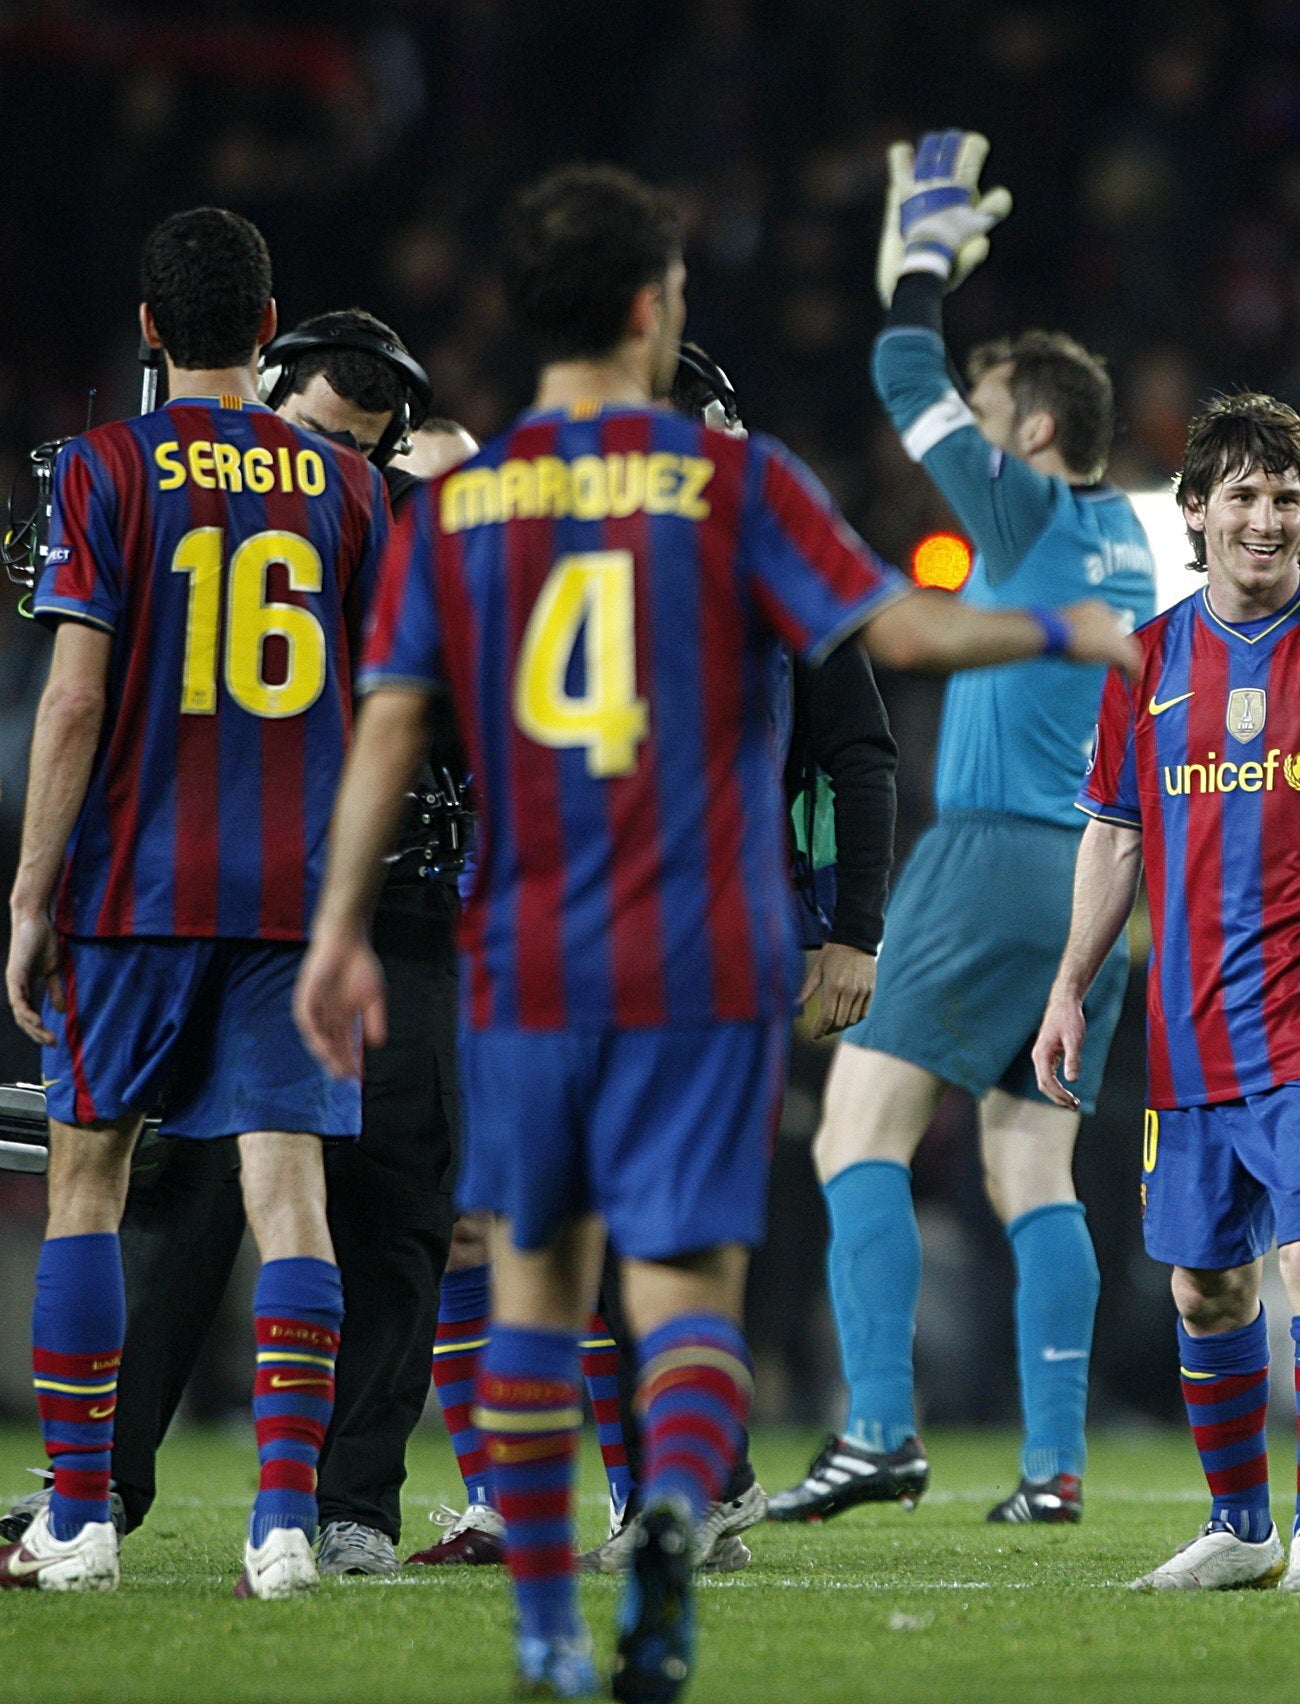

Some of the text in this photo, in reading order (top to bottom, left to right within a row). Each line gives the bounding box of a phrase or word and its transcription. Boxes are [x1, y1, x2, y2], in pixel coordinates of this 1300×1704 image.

[154, 440, 327, 497] SERGIO
[440, 450, 716, 535] MARQUEZ
[171, 525, 327, 719] 16
[514, 549, 649, 780] 4
[1237, 722, 1254, 730] FIFA
[1164, 748, 1281, 796] unicef
